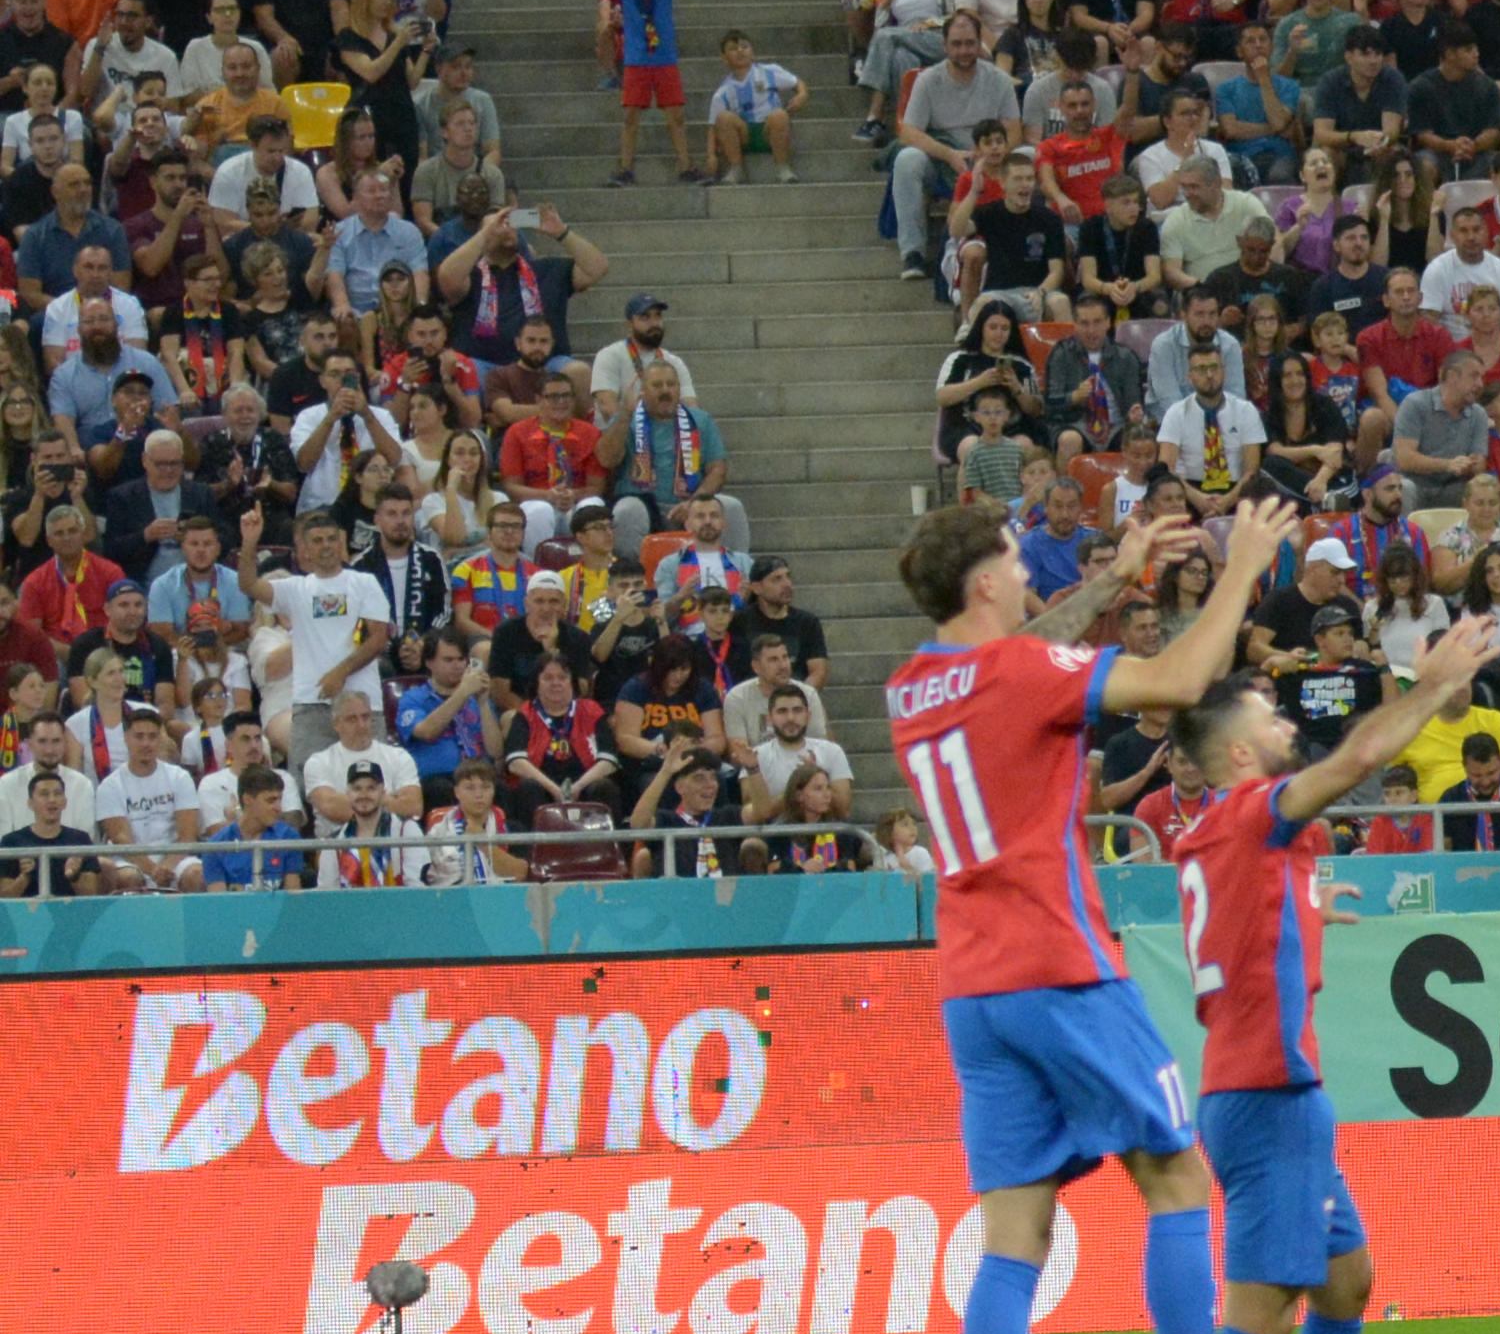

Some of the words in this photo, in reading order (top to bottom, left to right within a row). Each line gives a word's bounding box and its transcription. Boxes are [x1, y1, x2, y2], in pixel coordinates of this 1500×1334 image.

[906, 725, 1000, 879] 11
[116, 989, 768, 1174] Betano
[1156, 1061, 1193, 1131] 11
